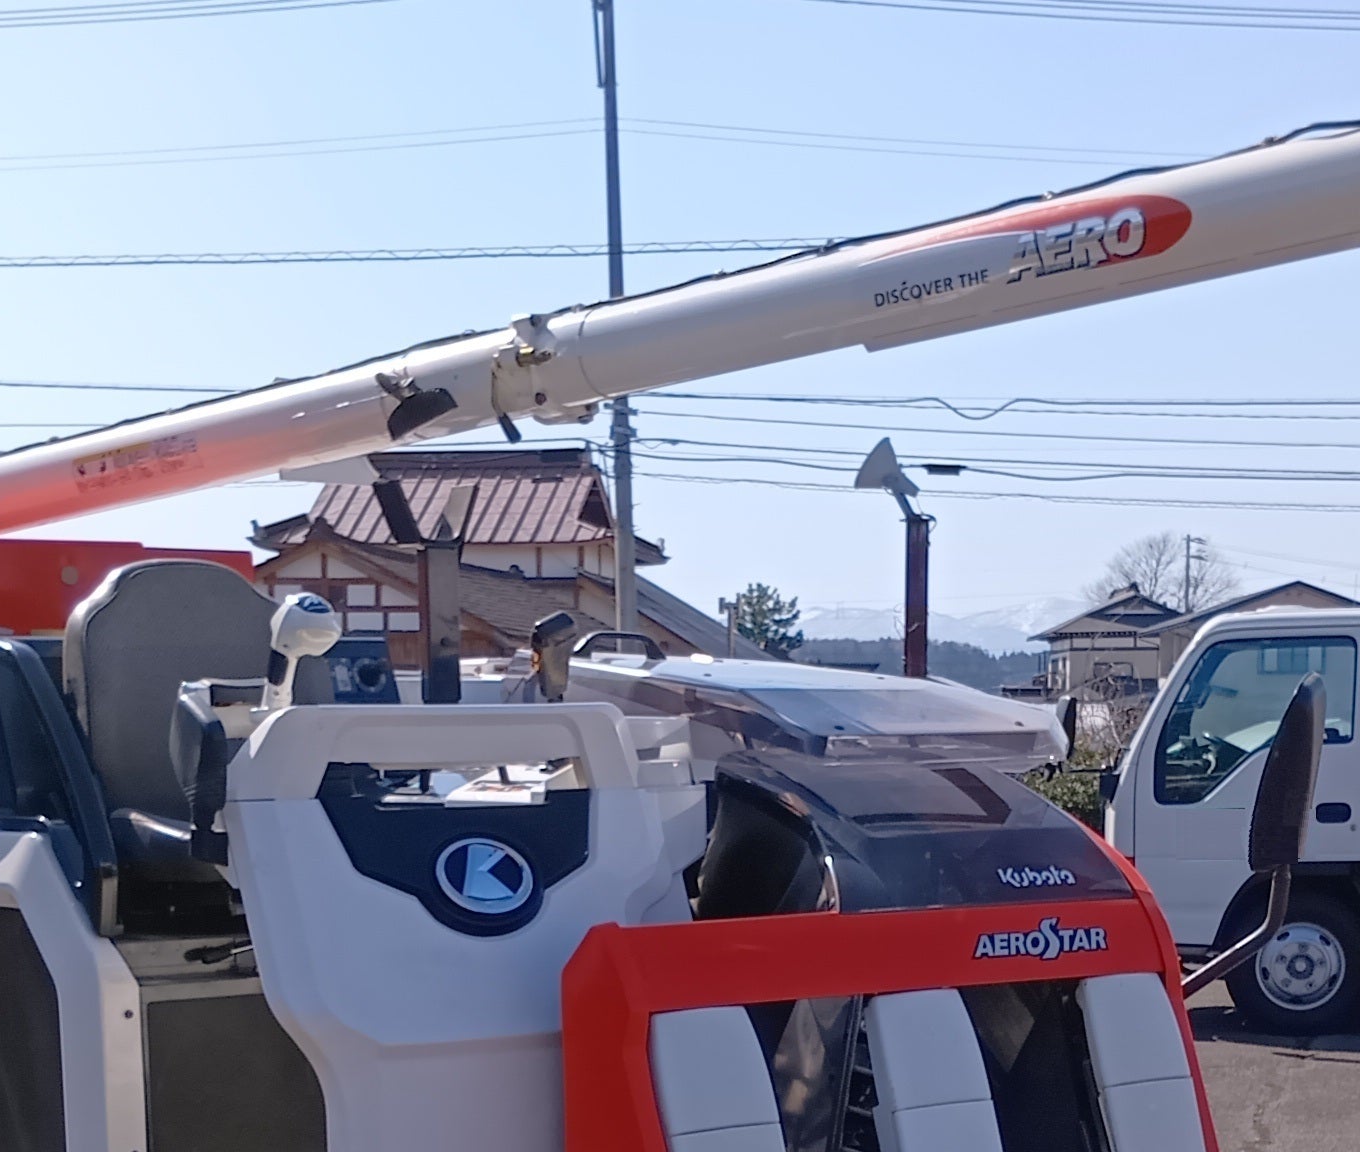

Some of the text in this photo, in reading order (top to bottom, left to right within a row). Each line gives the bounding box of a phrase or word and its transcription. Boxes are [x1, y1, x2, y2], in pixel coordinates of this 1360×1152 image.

[874, 206, 1147, 308] DISCOVER THE AERO
[997, 865, 1076, 888] Kubota
[972, 917, 1108, 960] AEROSTAR
